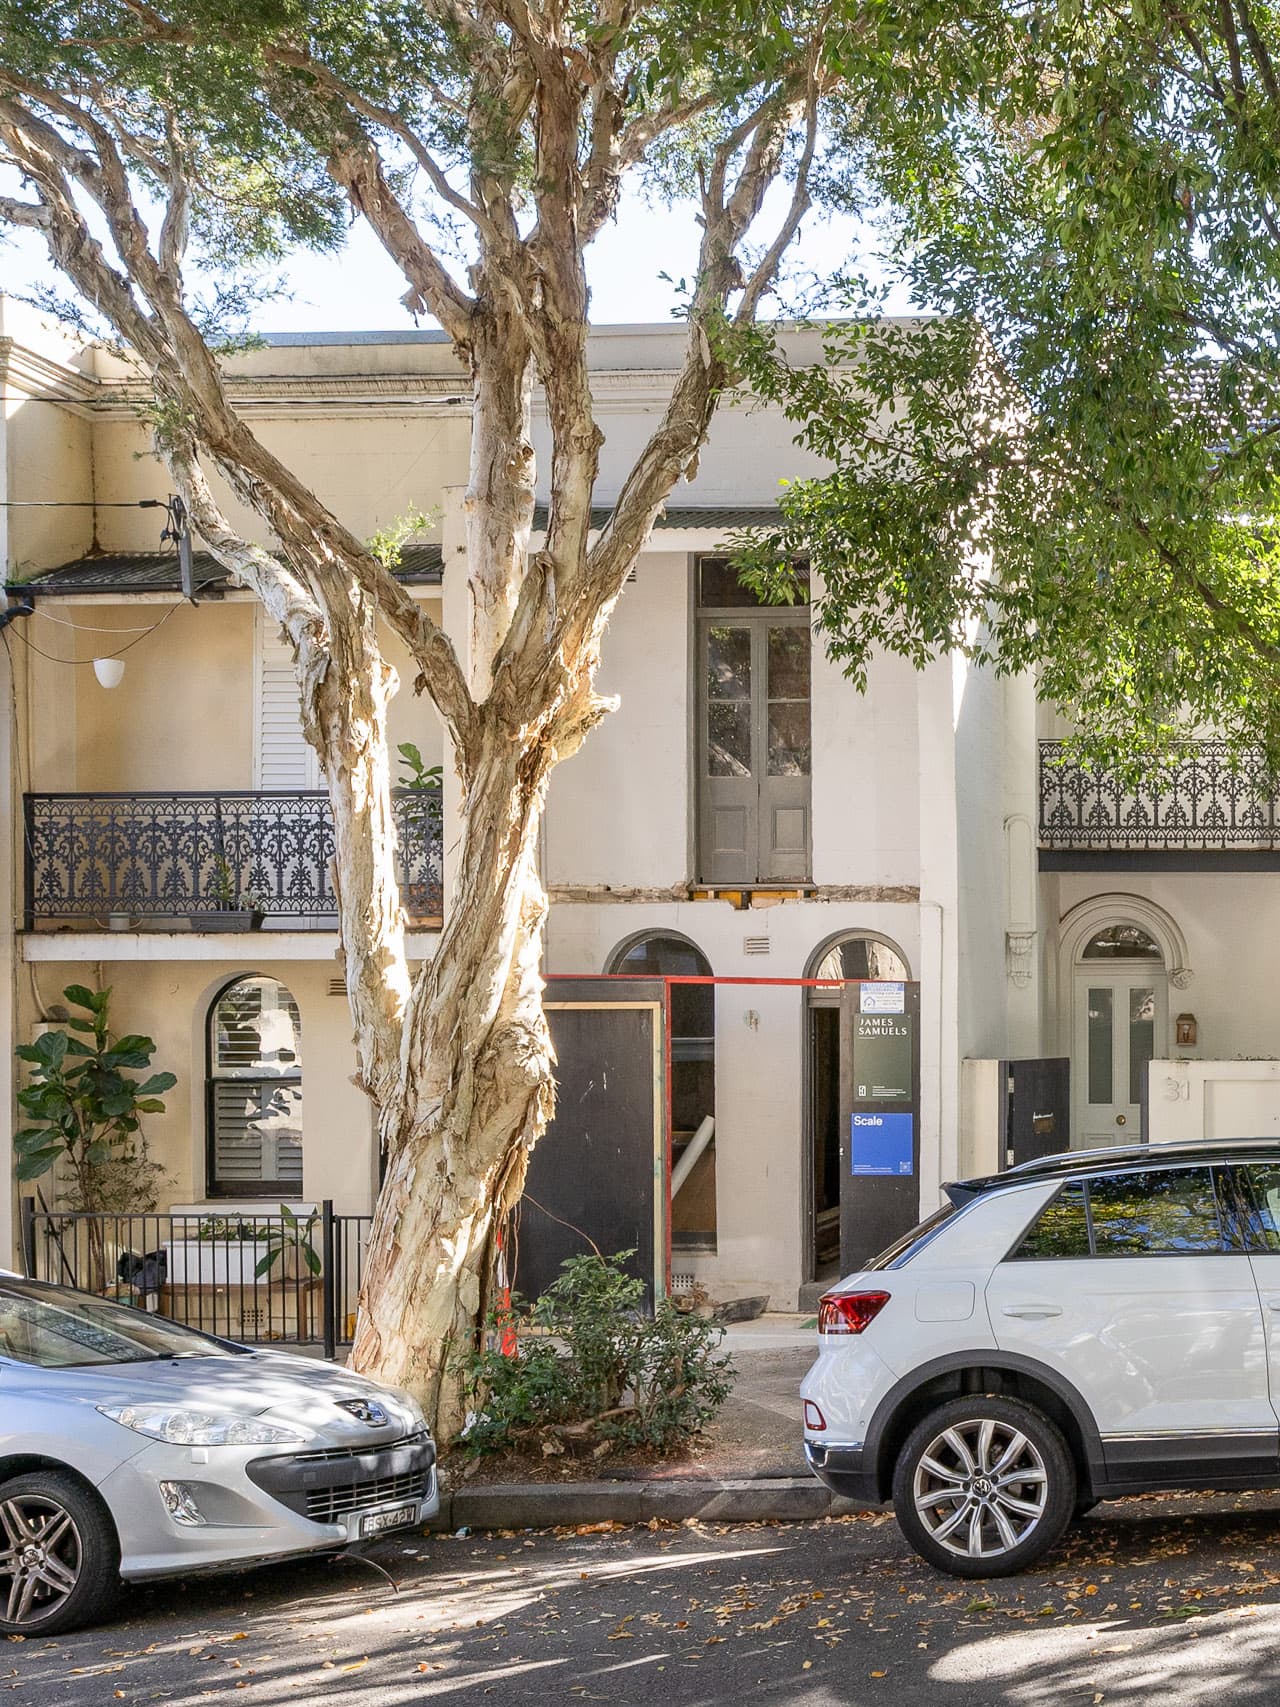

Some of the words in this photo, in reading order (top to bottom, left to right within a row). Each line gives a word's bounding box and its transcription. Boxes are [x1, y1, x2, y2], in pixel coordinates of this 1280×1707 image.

[860, 1018, 893, 1026] JAMES
[858, 1027, 907, 1036] SAMUELS
[1165, 1076, 1190, 1101] 31
[853, 1115, 883, 1126] Scale
